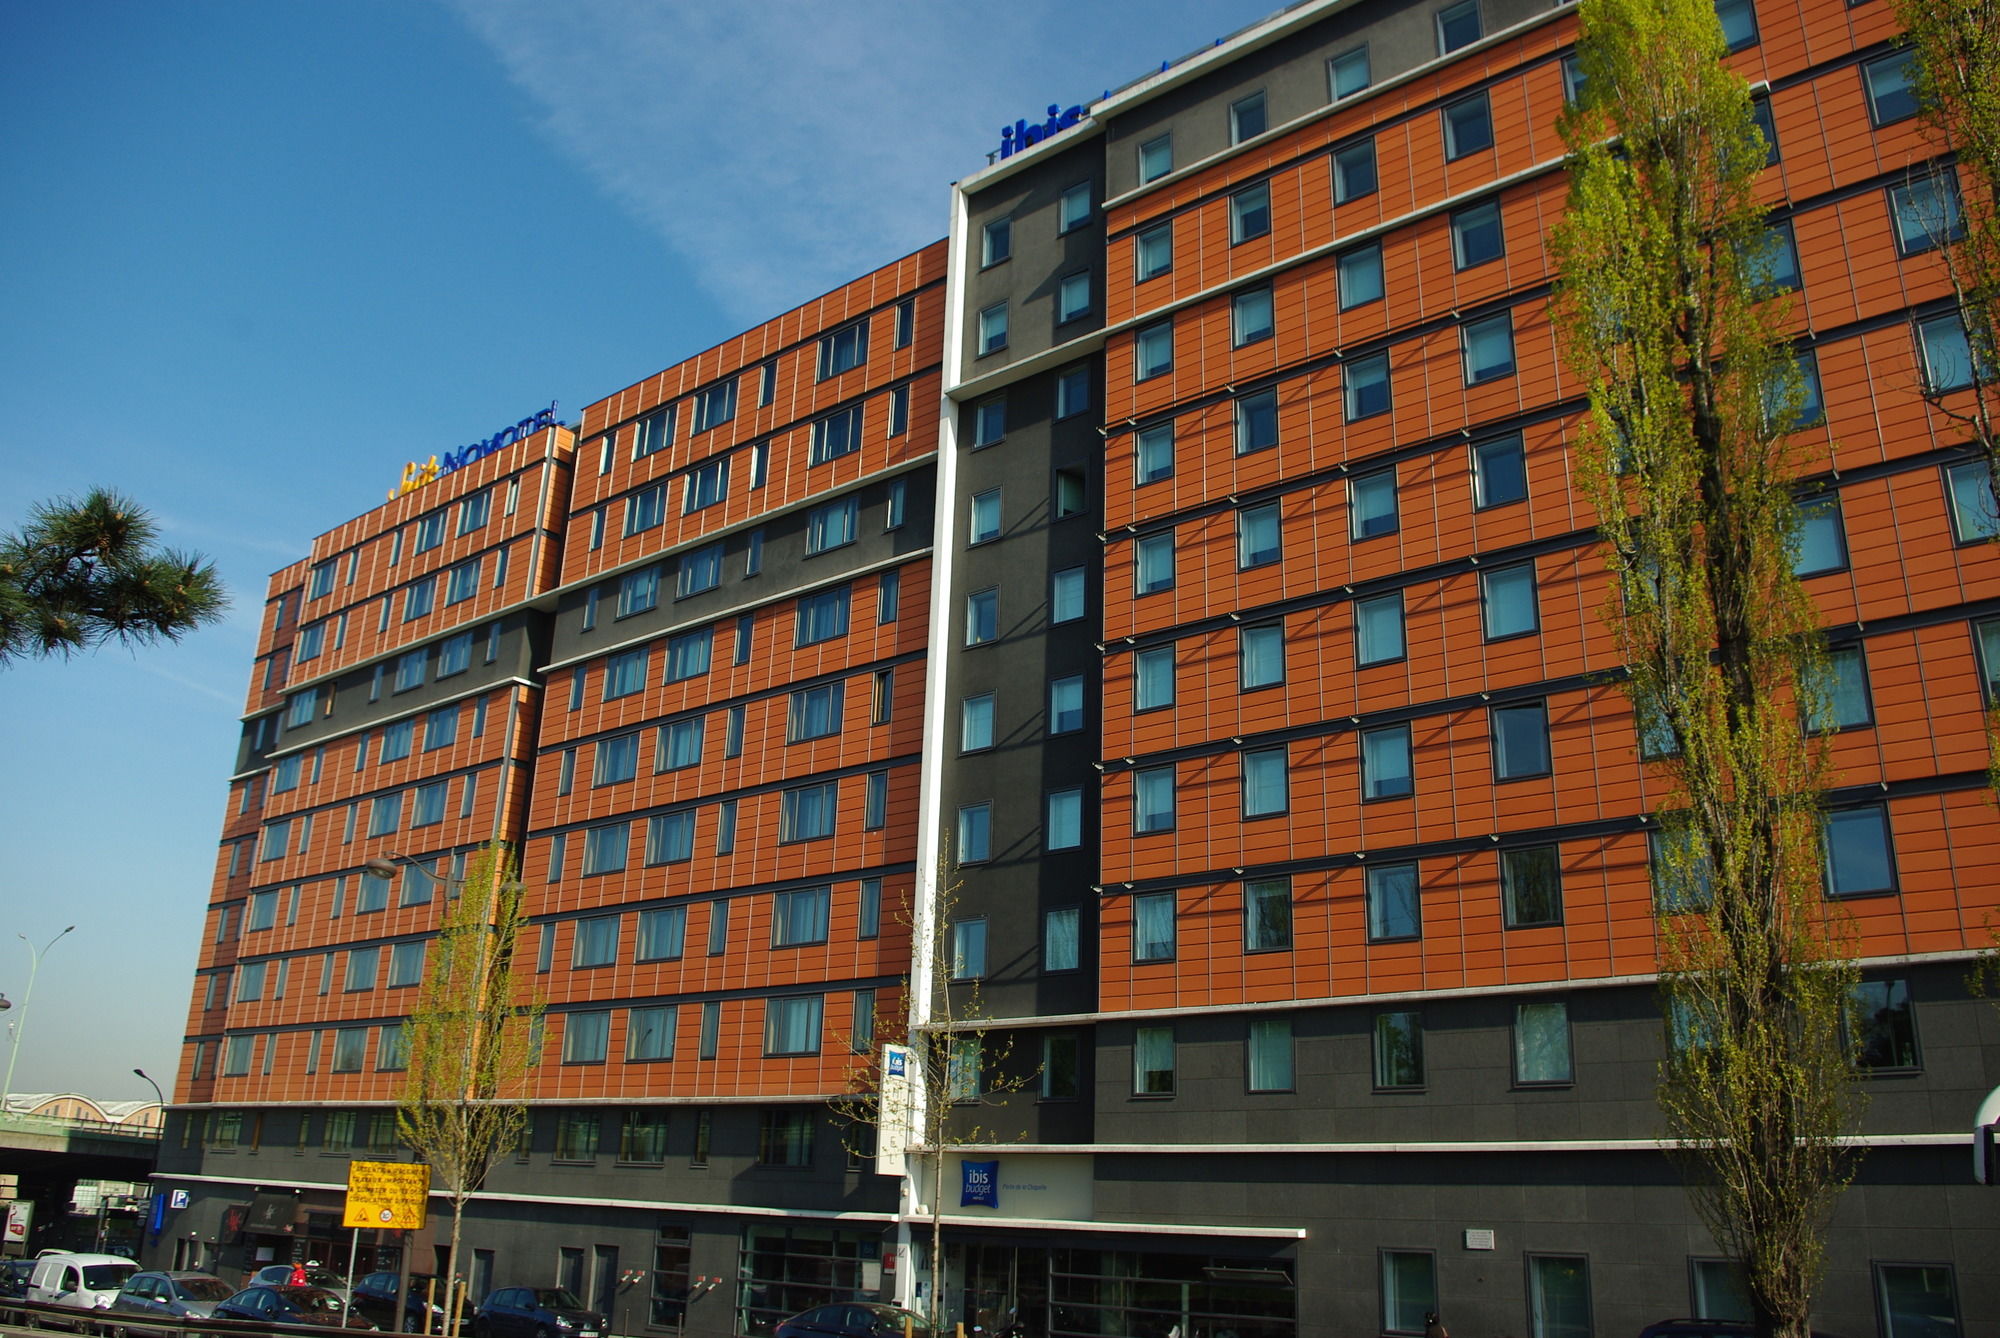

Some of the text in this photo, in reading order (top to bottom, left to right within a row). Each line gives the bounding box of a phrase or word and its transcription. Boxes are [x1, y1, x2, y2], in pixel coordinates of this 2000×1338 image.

[970, 1170, 988, 1184] ibis
[966, 1183, 991, 1196] budget
[176, 1192, 186, 1202] P
